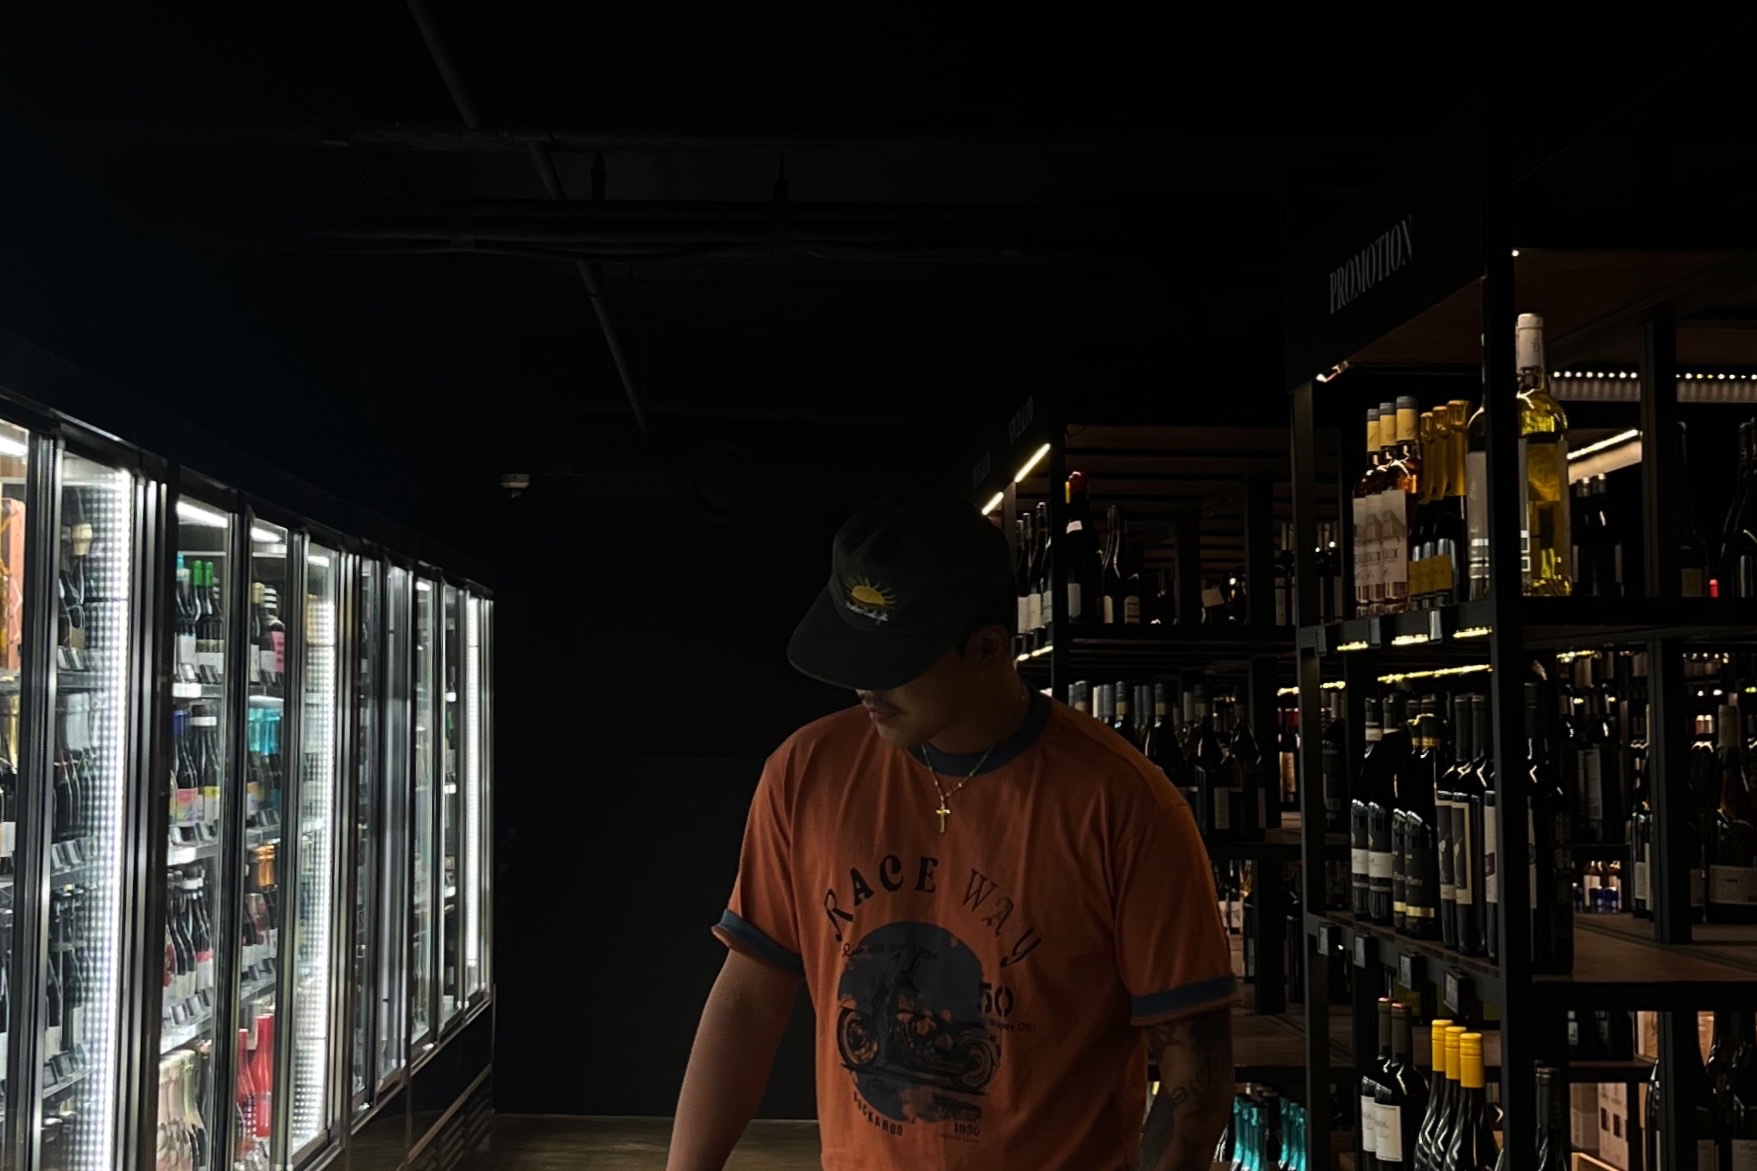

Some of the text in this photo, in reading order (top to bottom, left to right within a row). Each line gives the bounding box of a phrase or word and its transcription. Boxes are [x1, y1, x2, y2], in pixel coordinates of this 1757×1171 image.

[1329, 213, 1413, 315] PROMOTION
[824, 854, 1042, 968] RACE WAY
